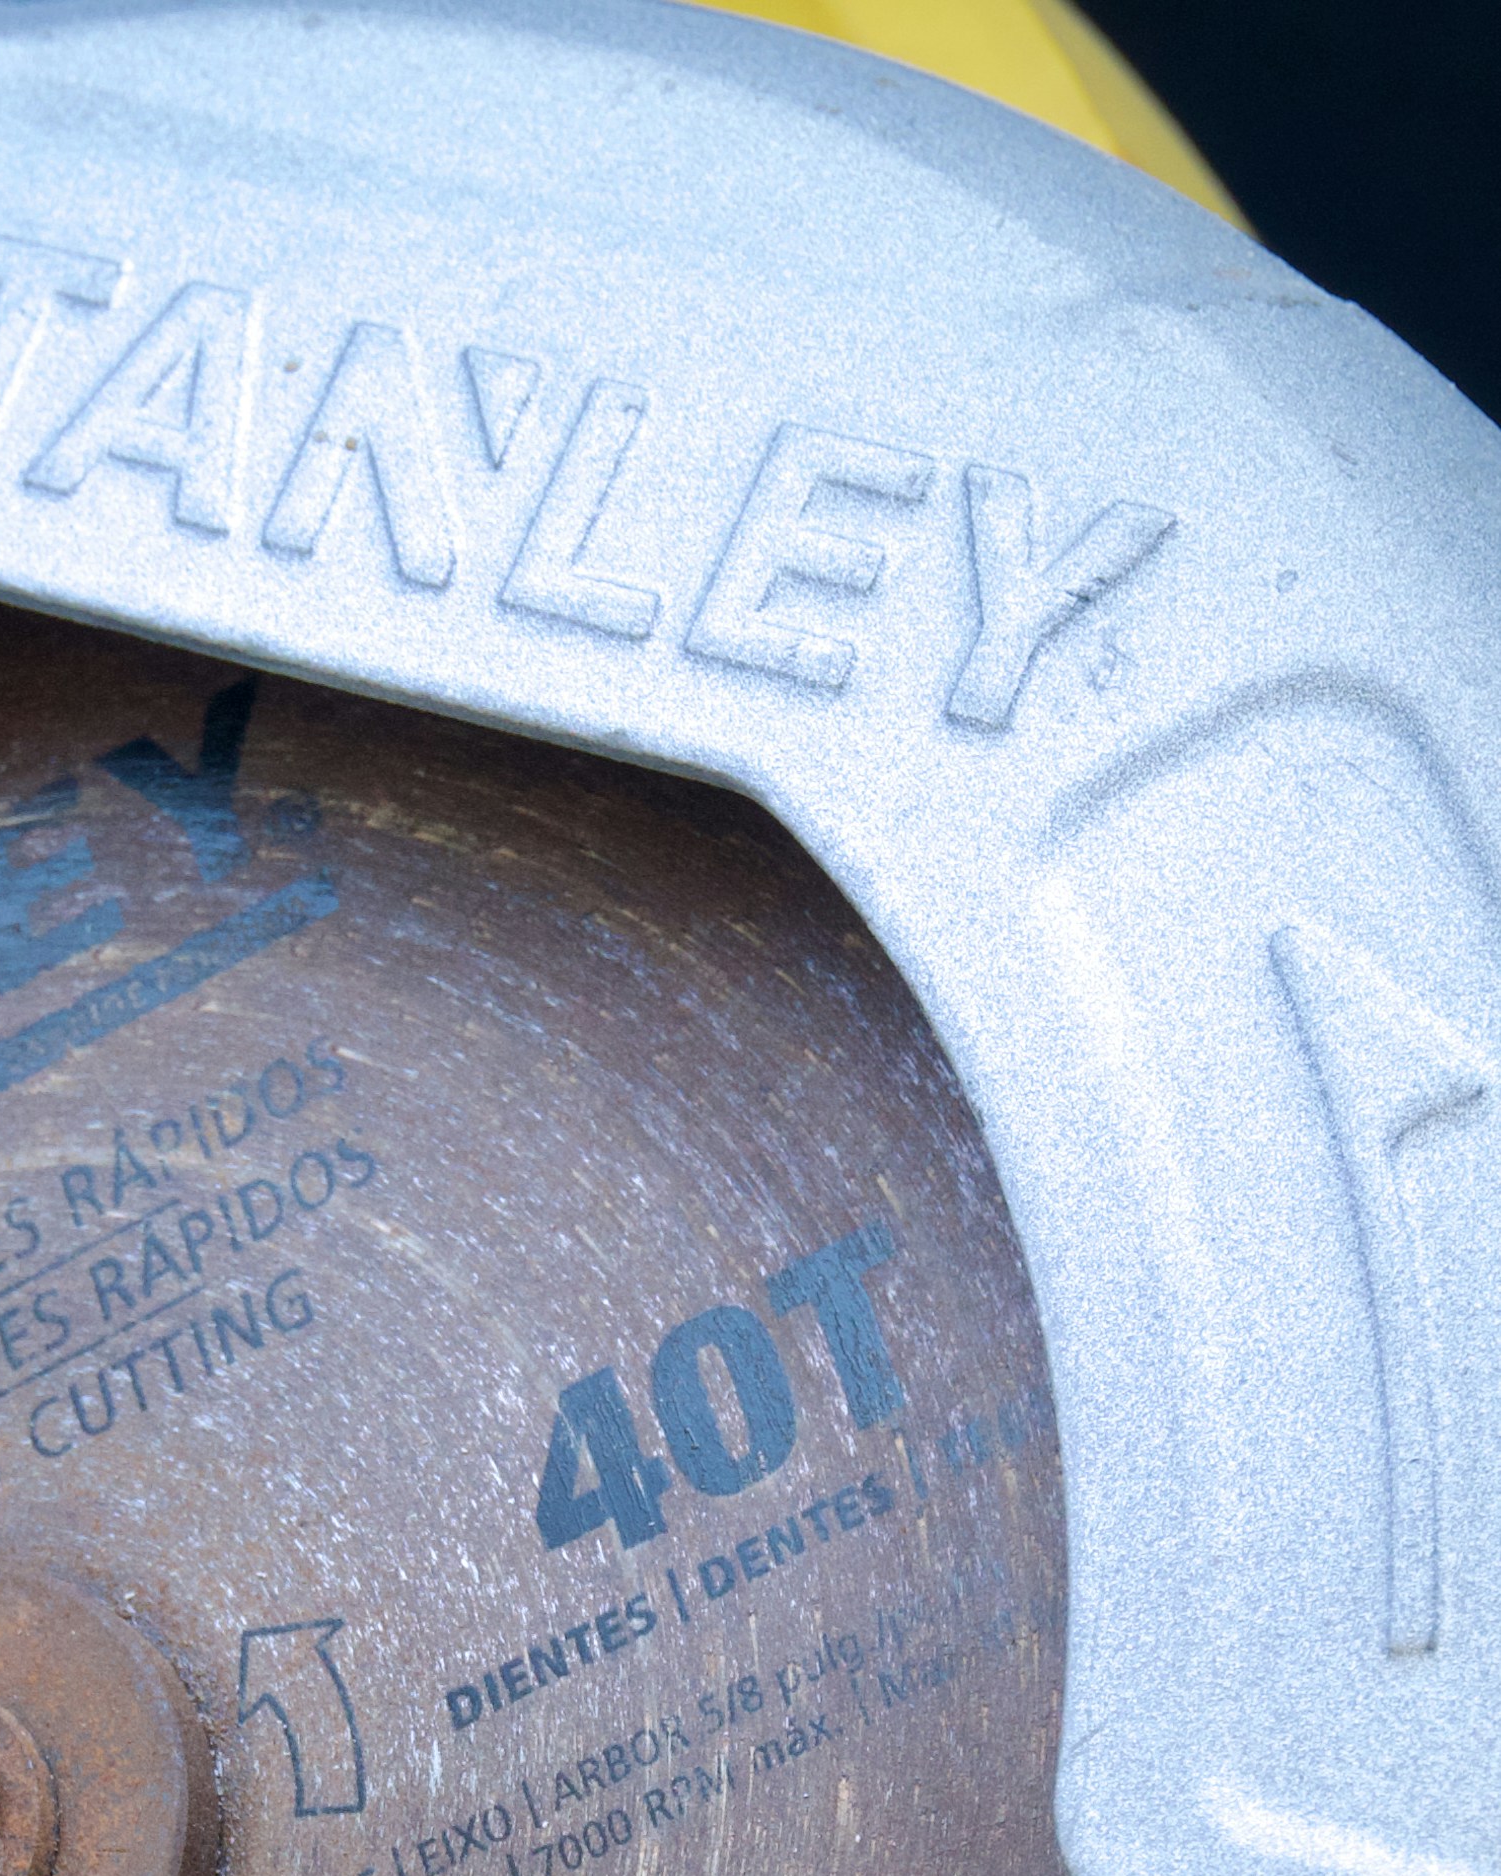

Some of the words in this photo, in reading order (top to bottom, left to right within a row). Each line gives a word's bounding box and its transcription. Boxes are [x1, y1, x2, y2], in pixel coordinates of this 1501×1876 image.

[28, 1267, 315, 1458] CUTTING
[534, 1220, 903, 1550] 40T
[445, 1595, 658, 1730] DIENTES
[697, 1472, 897, 1601] DENTES
[554, 1713, 691, 1811] ARBOR
[699, 1675, 764, 1734] 5/8
[645, 1761, 737, 1829] RPM
